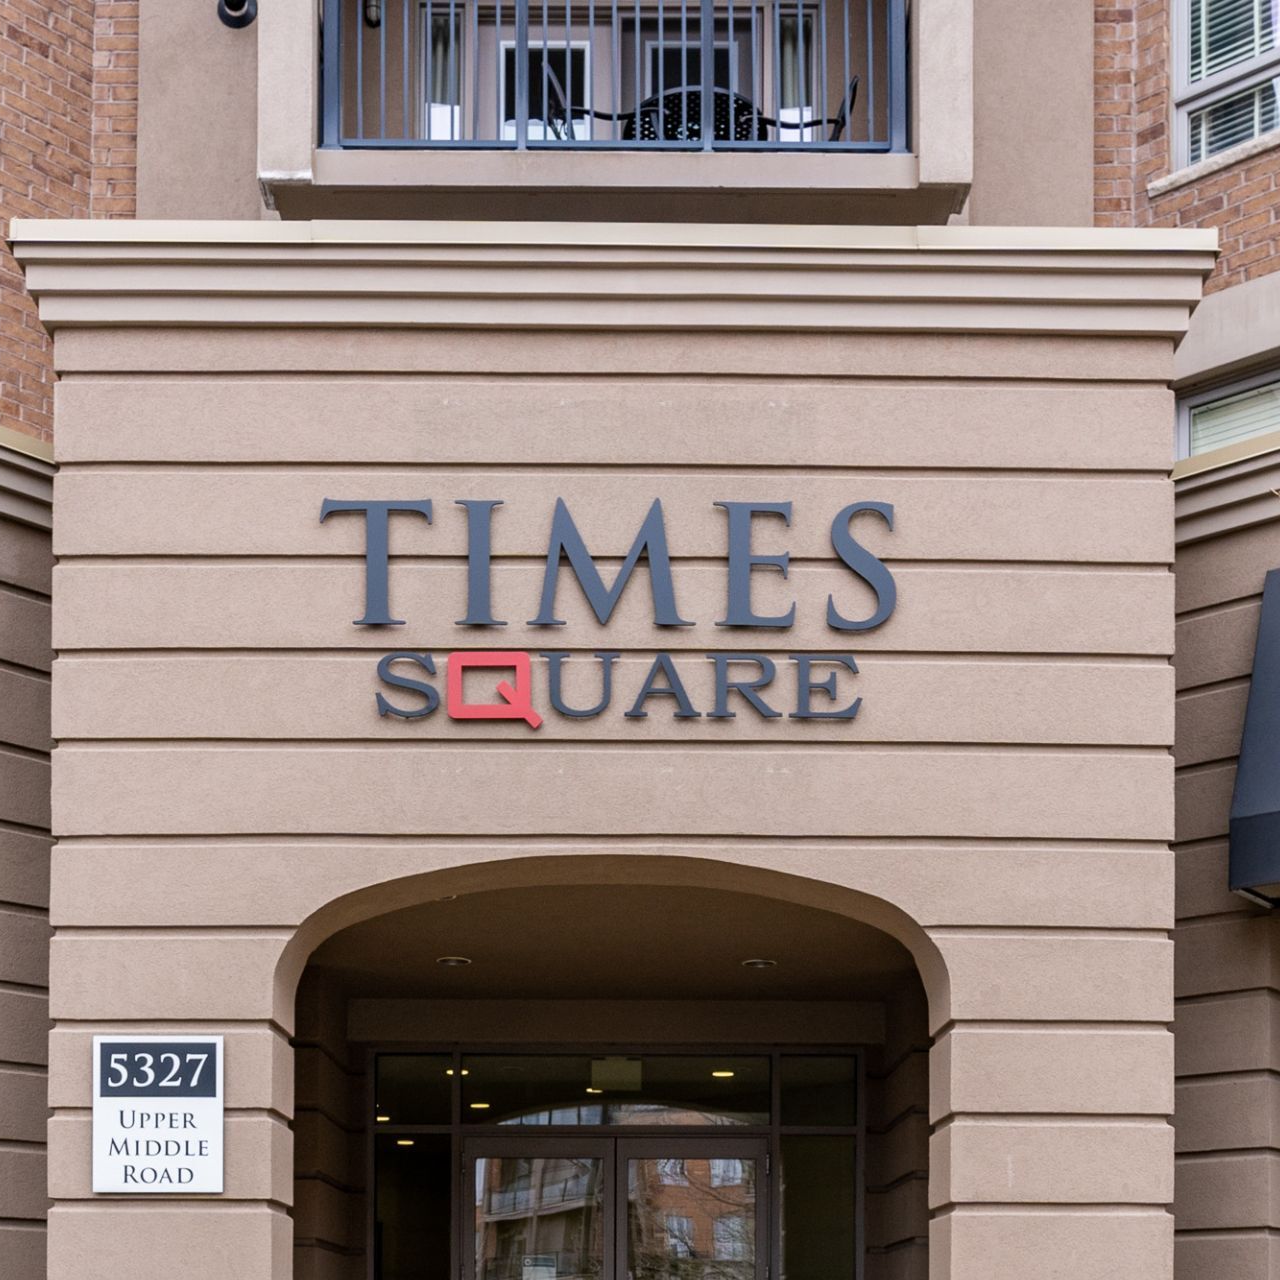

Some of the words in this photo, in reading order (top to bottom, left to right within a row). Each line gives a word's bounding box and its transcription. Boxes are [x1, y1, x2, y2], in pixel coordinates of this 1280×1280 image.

[320, 497, 897, 631] TIMES
[375, 651, 863, 729] SQUARE
[107, 1053, 209, 1088] 5327
[119, 1110, 198, 1129] UPPER
[108, 1137, 209, 1157] MIDDLE
[123, 1164, 194, 1184] ROAD
